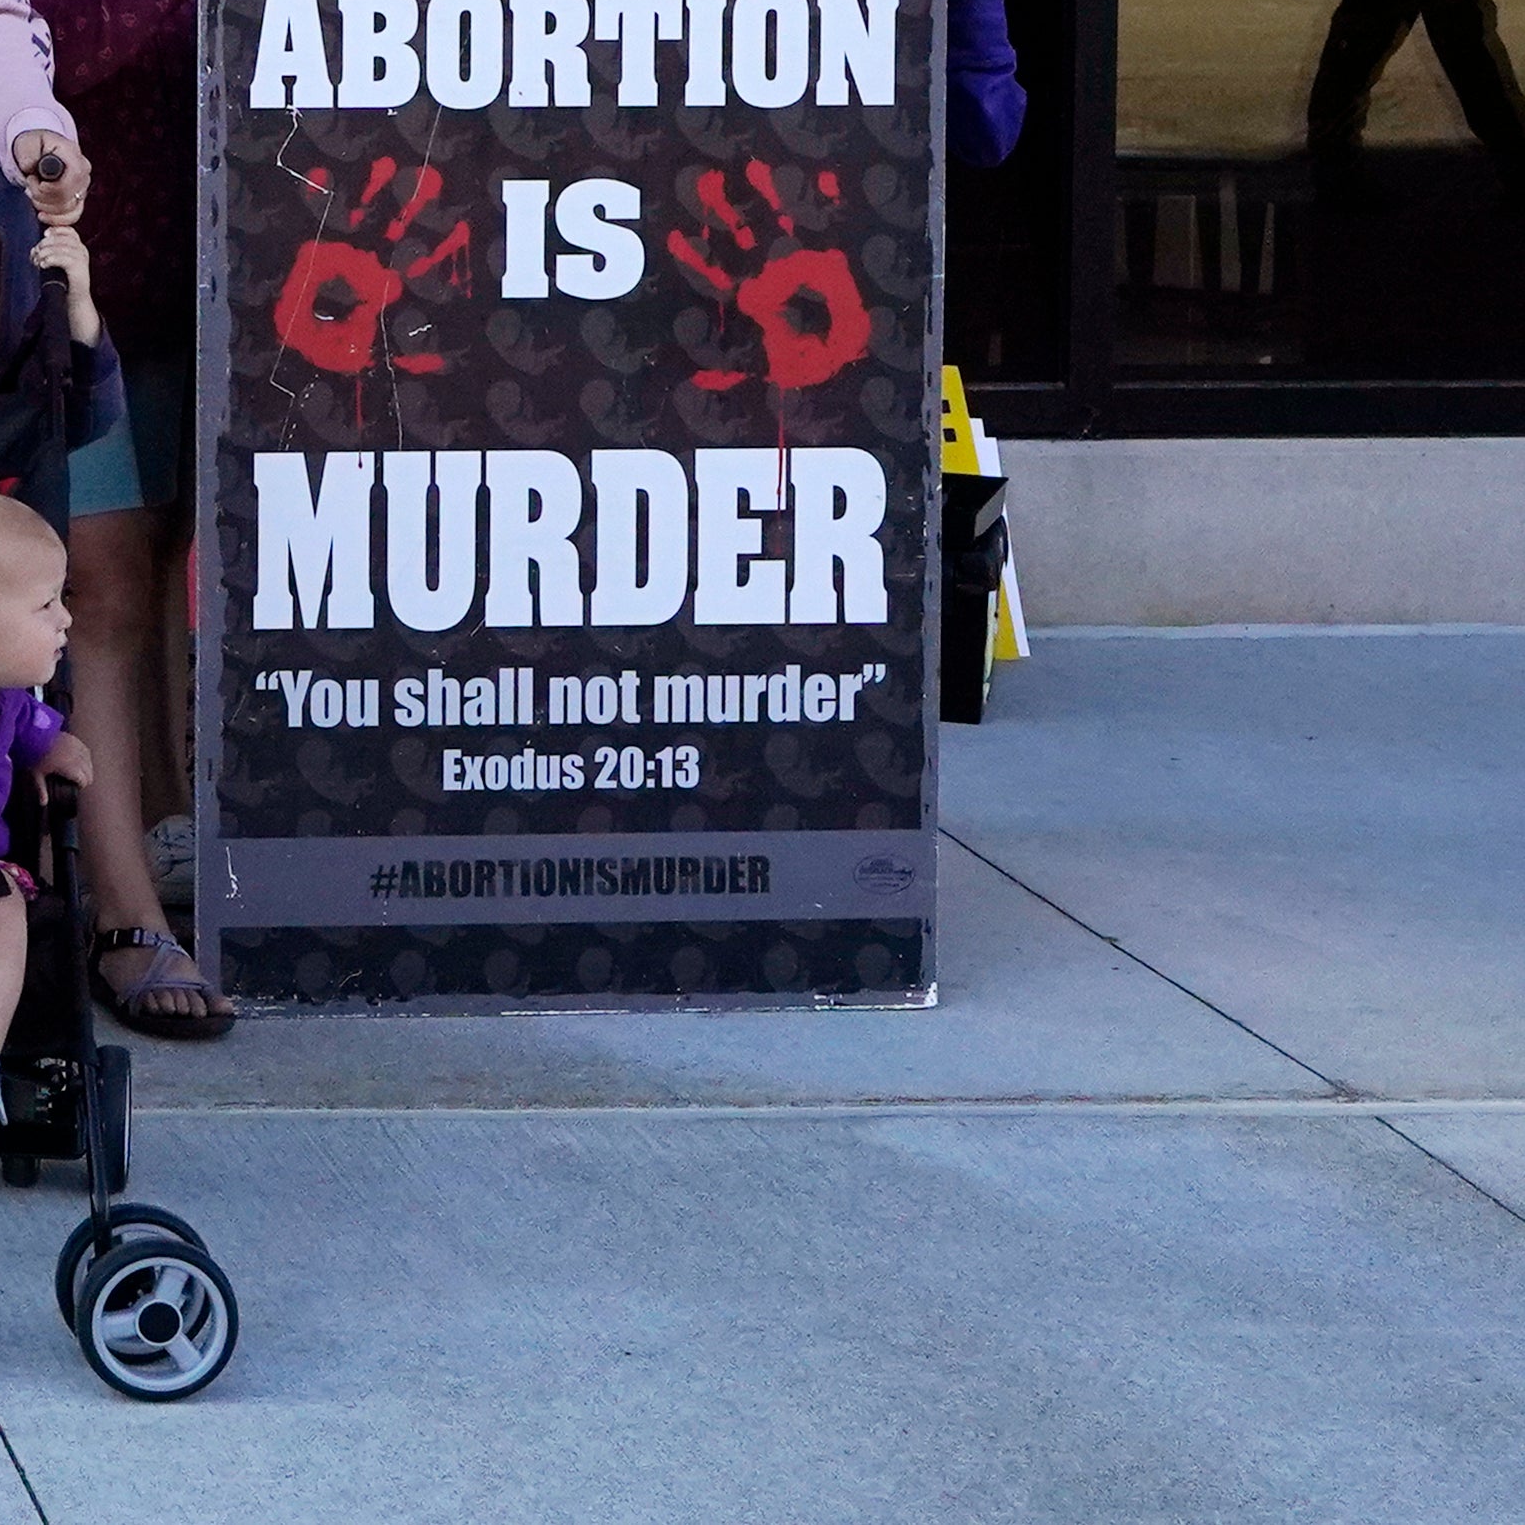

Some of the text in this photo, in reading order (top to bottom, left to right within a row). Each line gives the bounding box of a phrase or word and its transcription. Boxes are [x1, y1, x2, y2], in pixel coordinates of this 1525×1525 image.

[501, 179, 646, 302] IS
[252, 447, 890, 633] MURDER
[394, 667, 535, 729] shall
[549, 671, 642, 726] not
[442, 745, 702, 793] Exodus 20:13
[369, 854, 772, 900] #ABORTIONISMURDER
